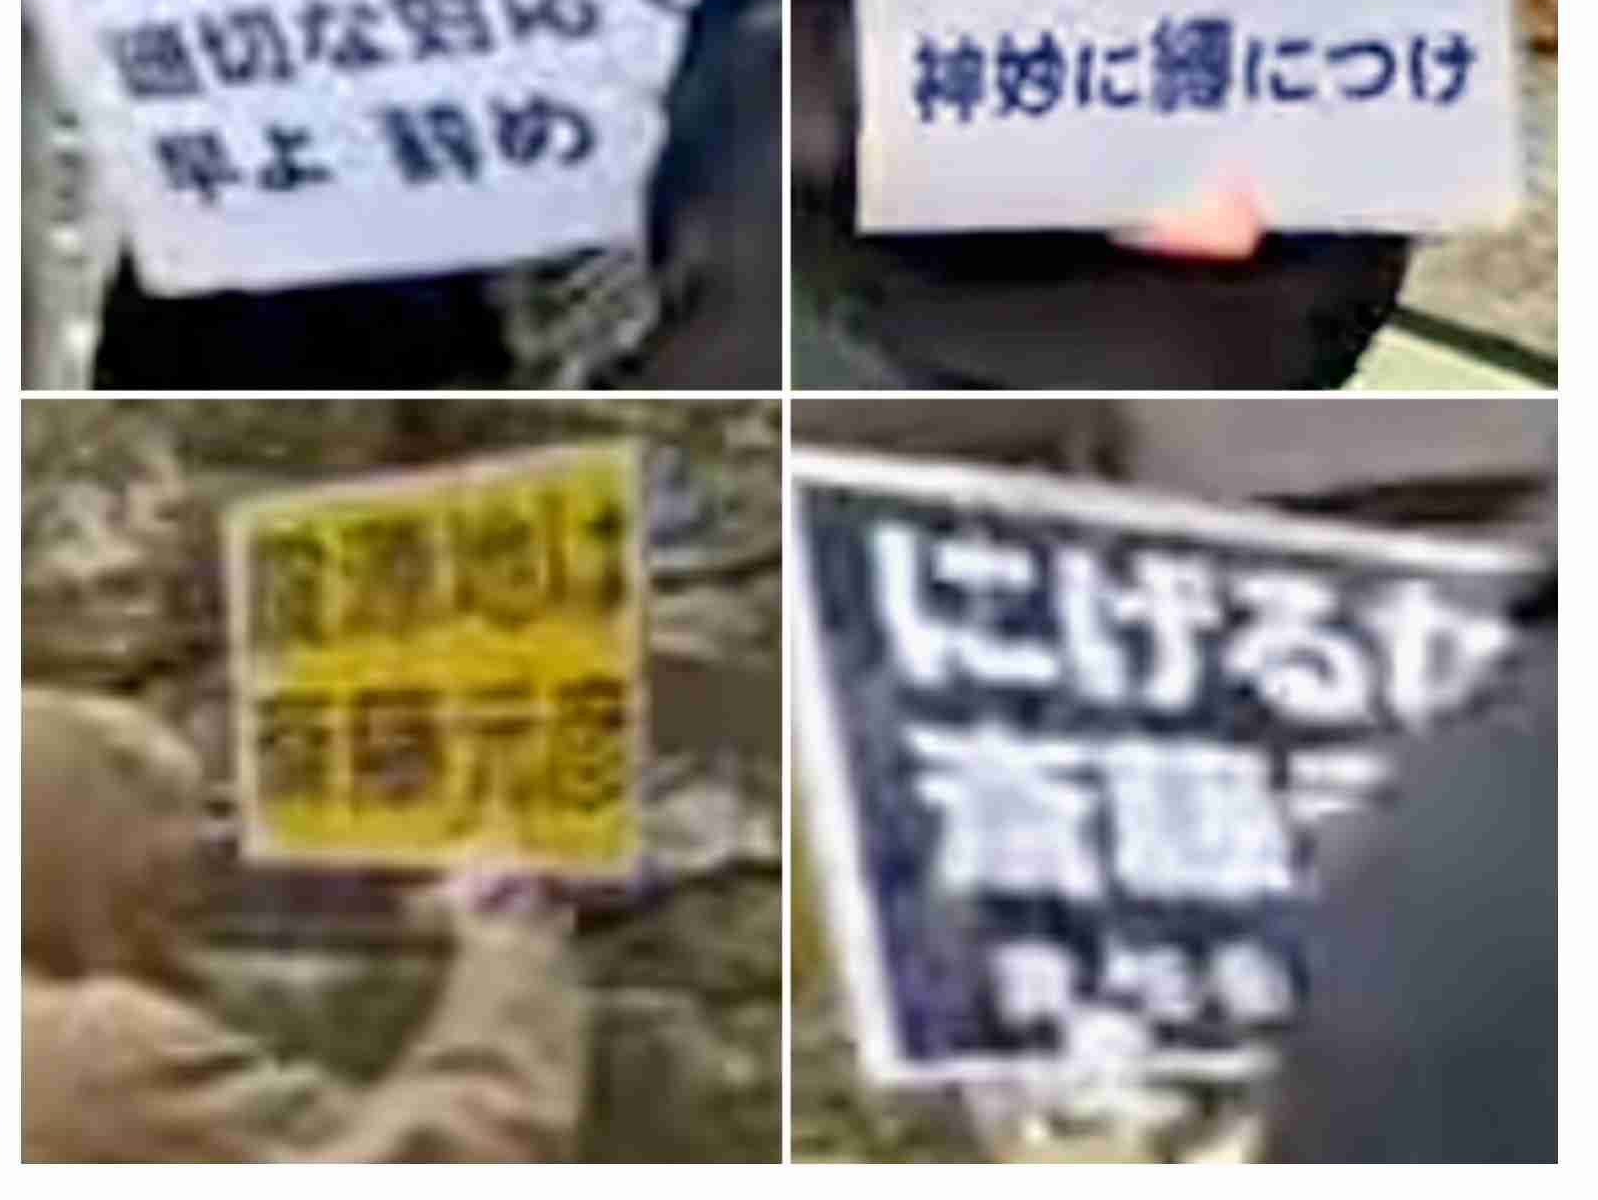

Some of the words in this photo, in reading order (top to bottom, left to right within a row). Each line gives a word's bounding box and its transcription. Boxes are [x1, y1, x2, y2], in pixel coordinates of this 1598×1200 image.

[912, 16, 1478, 124] 神妙に縛につけ
